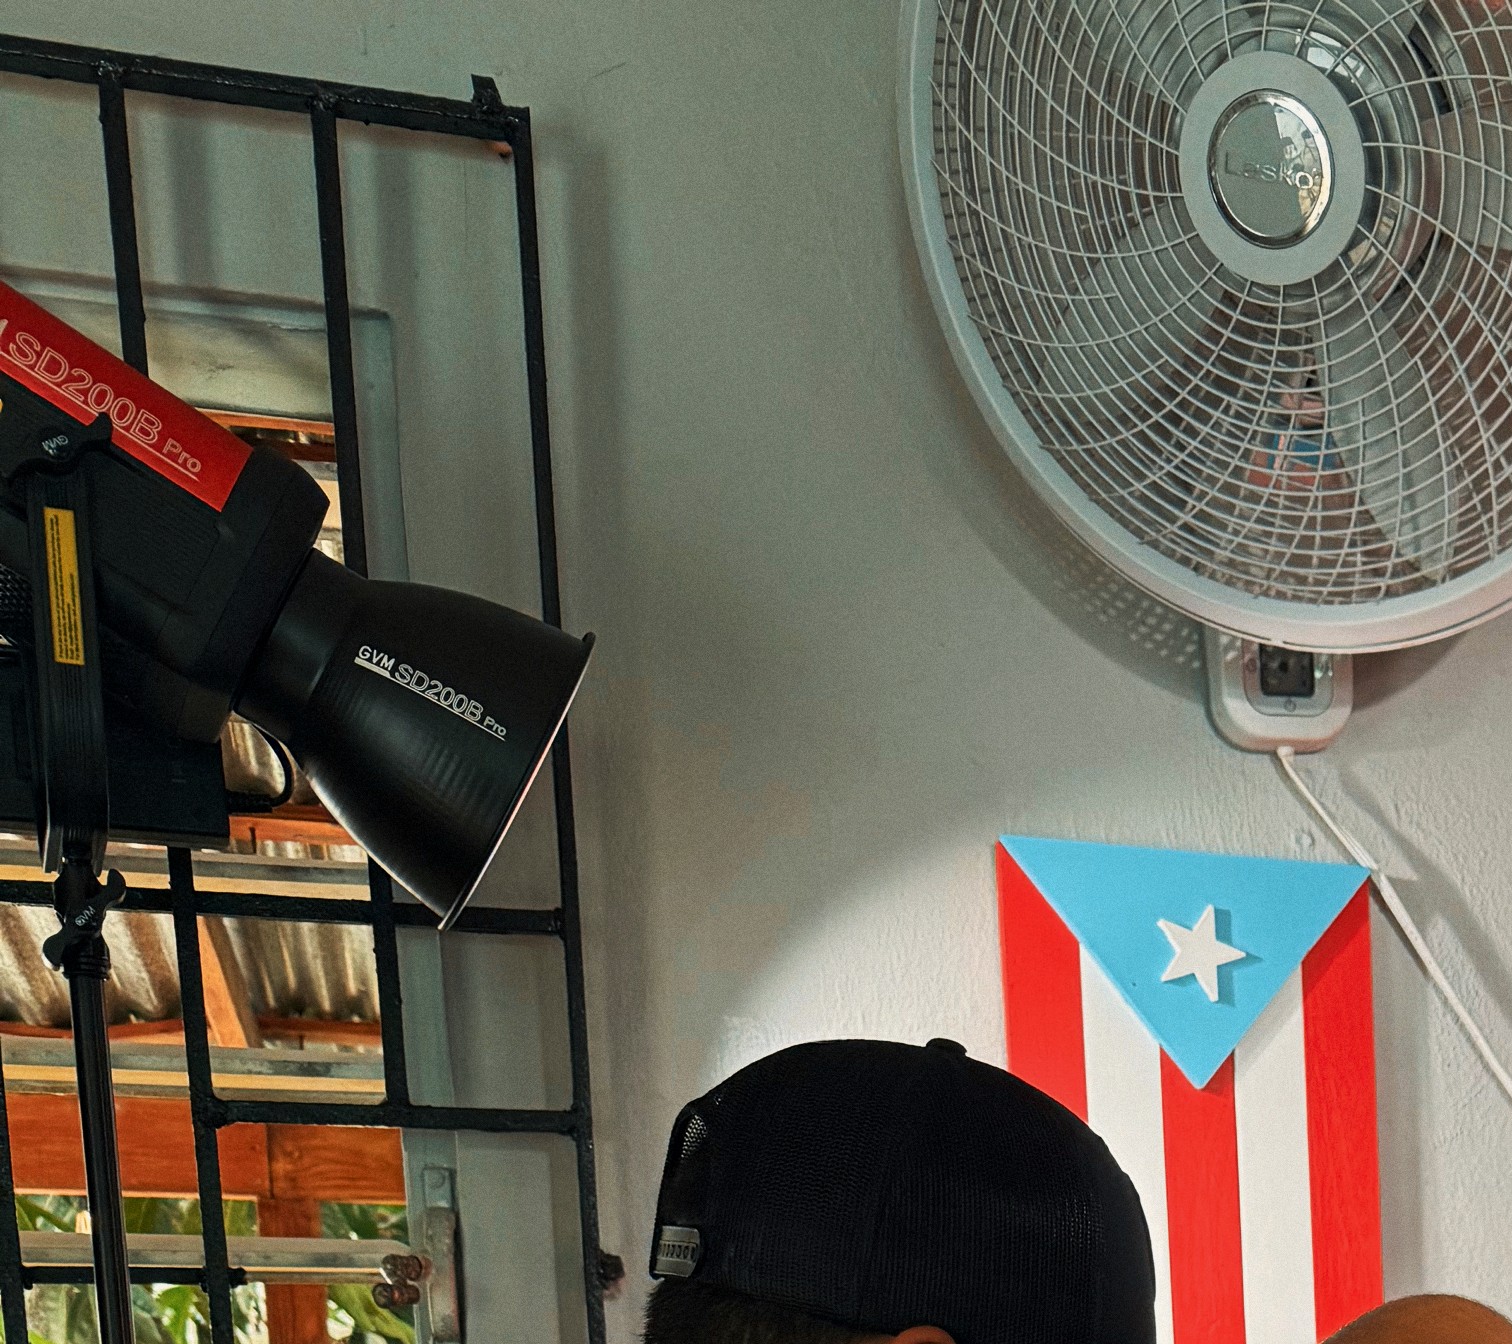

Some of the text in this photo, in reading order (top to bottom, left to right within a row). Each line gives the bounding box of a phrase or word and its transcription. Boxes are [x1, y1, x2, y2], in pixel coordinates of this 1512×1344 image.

[1224, 151, 1314, 189] Lasko
[9, 331, 202, 474] SD200B Pro
[358, 645, 507, 737] GVM SD200B Pro
